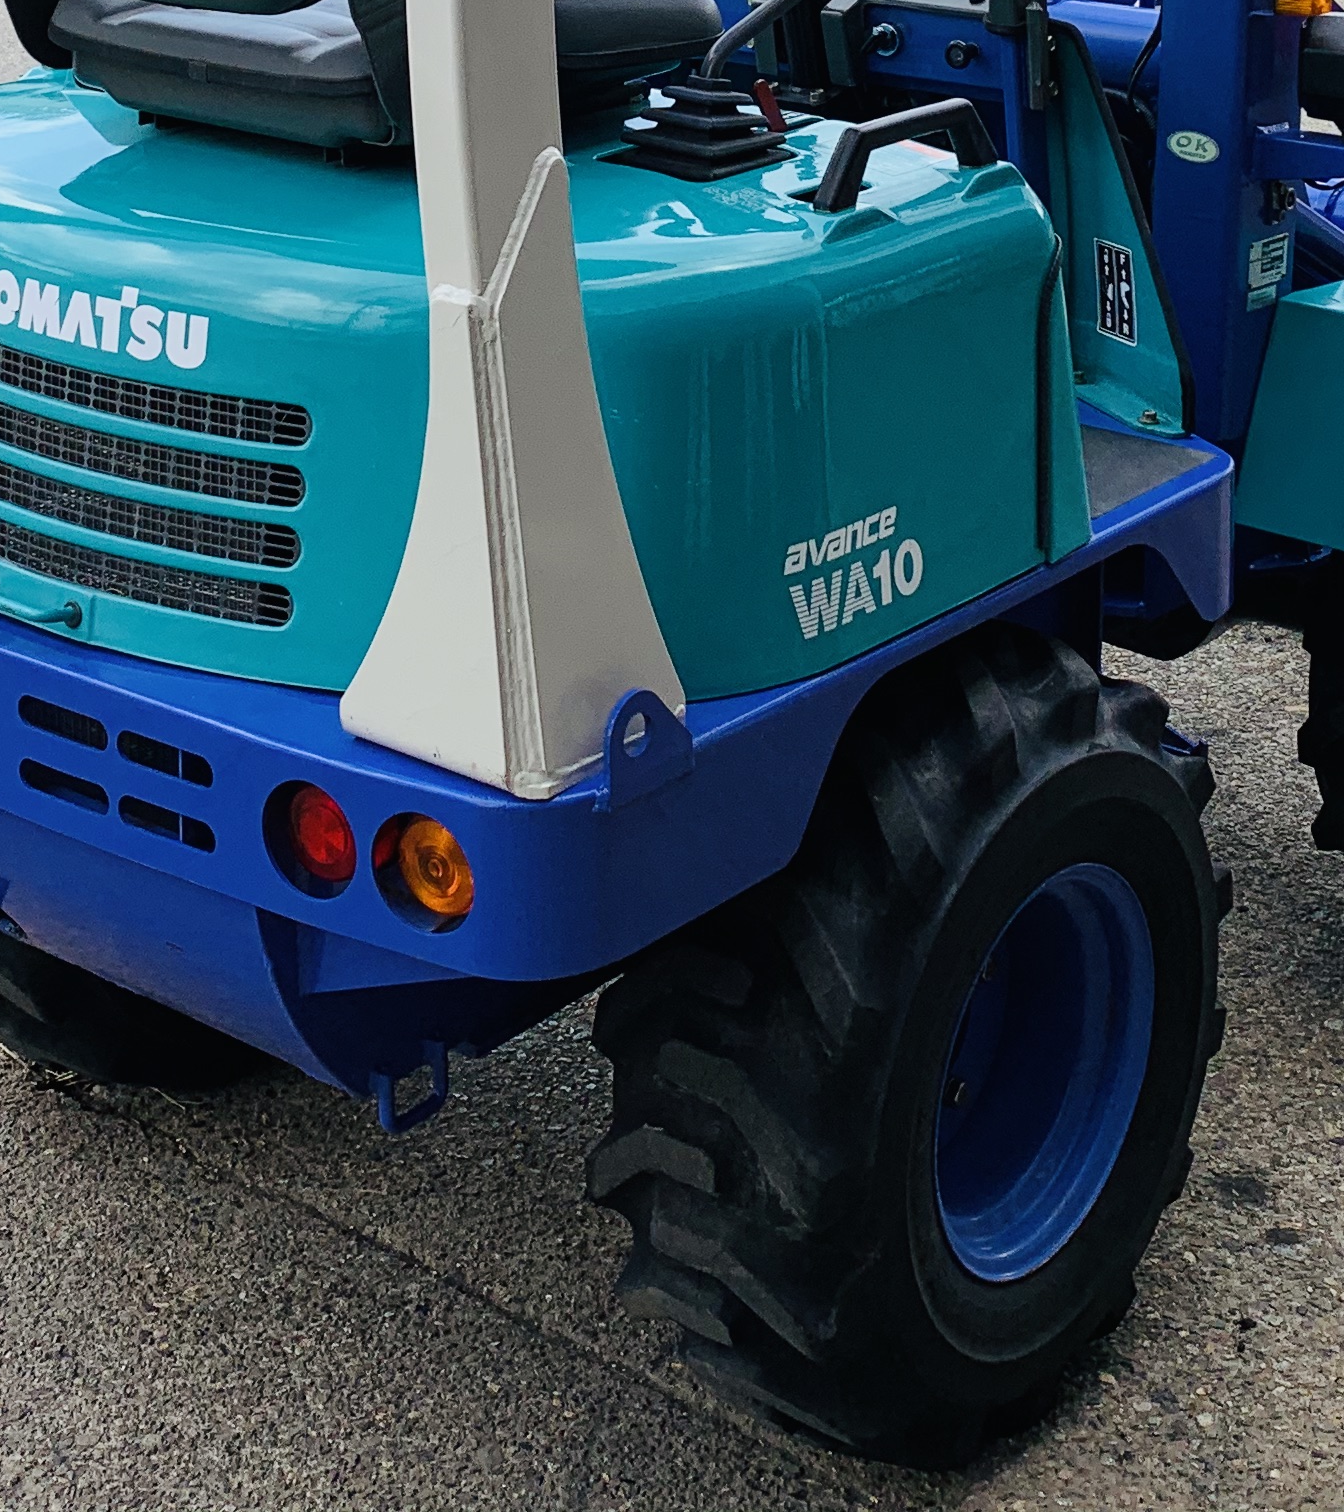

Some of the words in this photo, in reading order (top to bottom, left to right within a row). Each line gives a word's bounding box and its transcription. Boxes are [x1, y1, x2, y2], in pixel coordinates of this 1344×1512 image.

[1176, 135, 1209, 153] OK
[783, 506, 897, 575] avance
[789, 539, 923, 639] WA10
